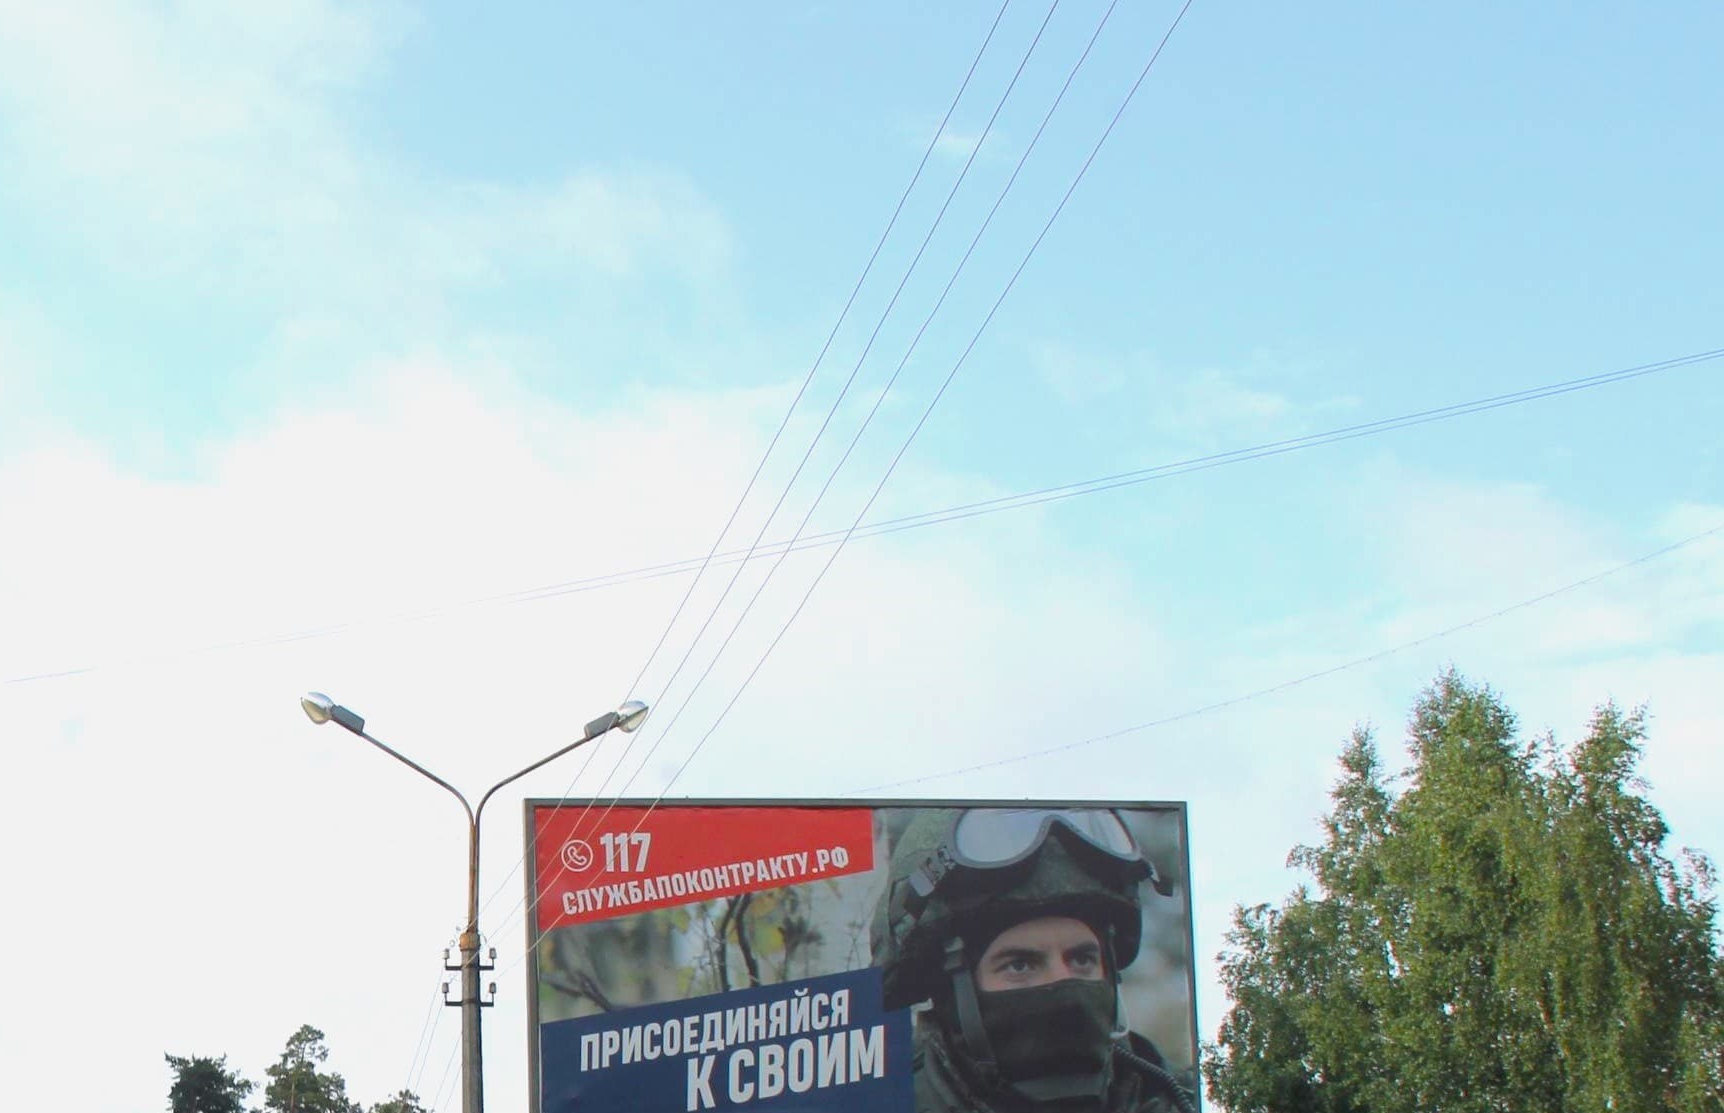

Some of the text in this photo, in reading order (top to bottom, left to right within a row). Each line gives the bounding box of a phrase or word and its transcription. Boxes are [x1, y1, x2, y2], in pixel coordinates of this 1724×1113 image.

[562, 846, 850, 916] СЛУЖБАПОКОНТРАКТУ.РФ
[599, 832, 652, 873] 117
[580, 987, 852, 1072] ПРИСОЕДИНЯЙСЯ
[686, 1024, 886, 1112] К СВОИМ
